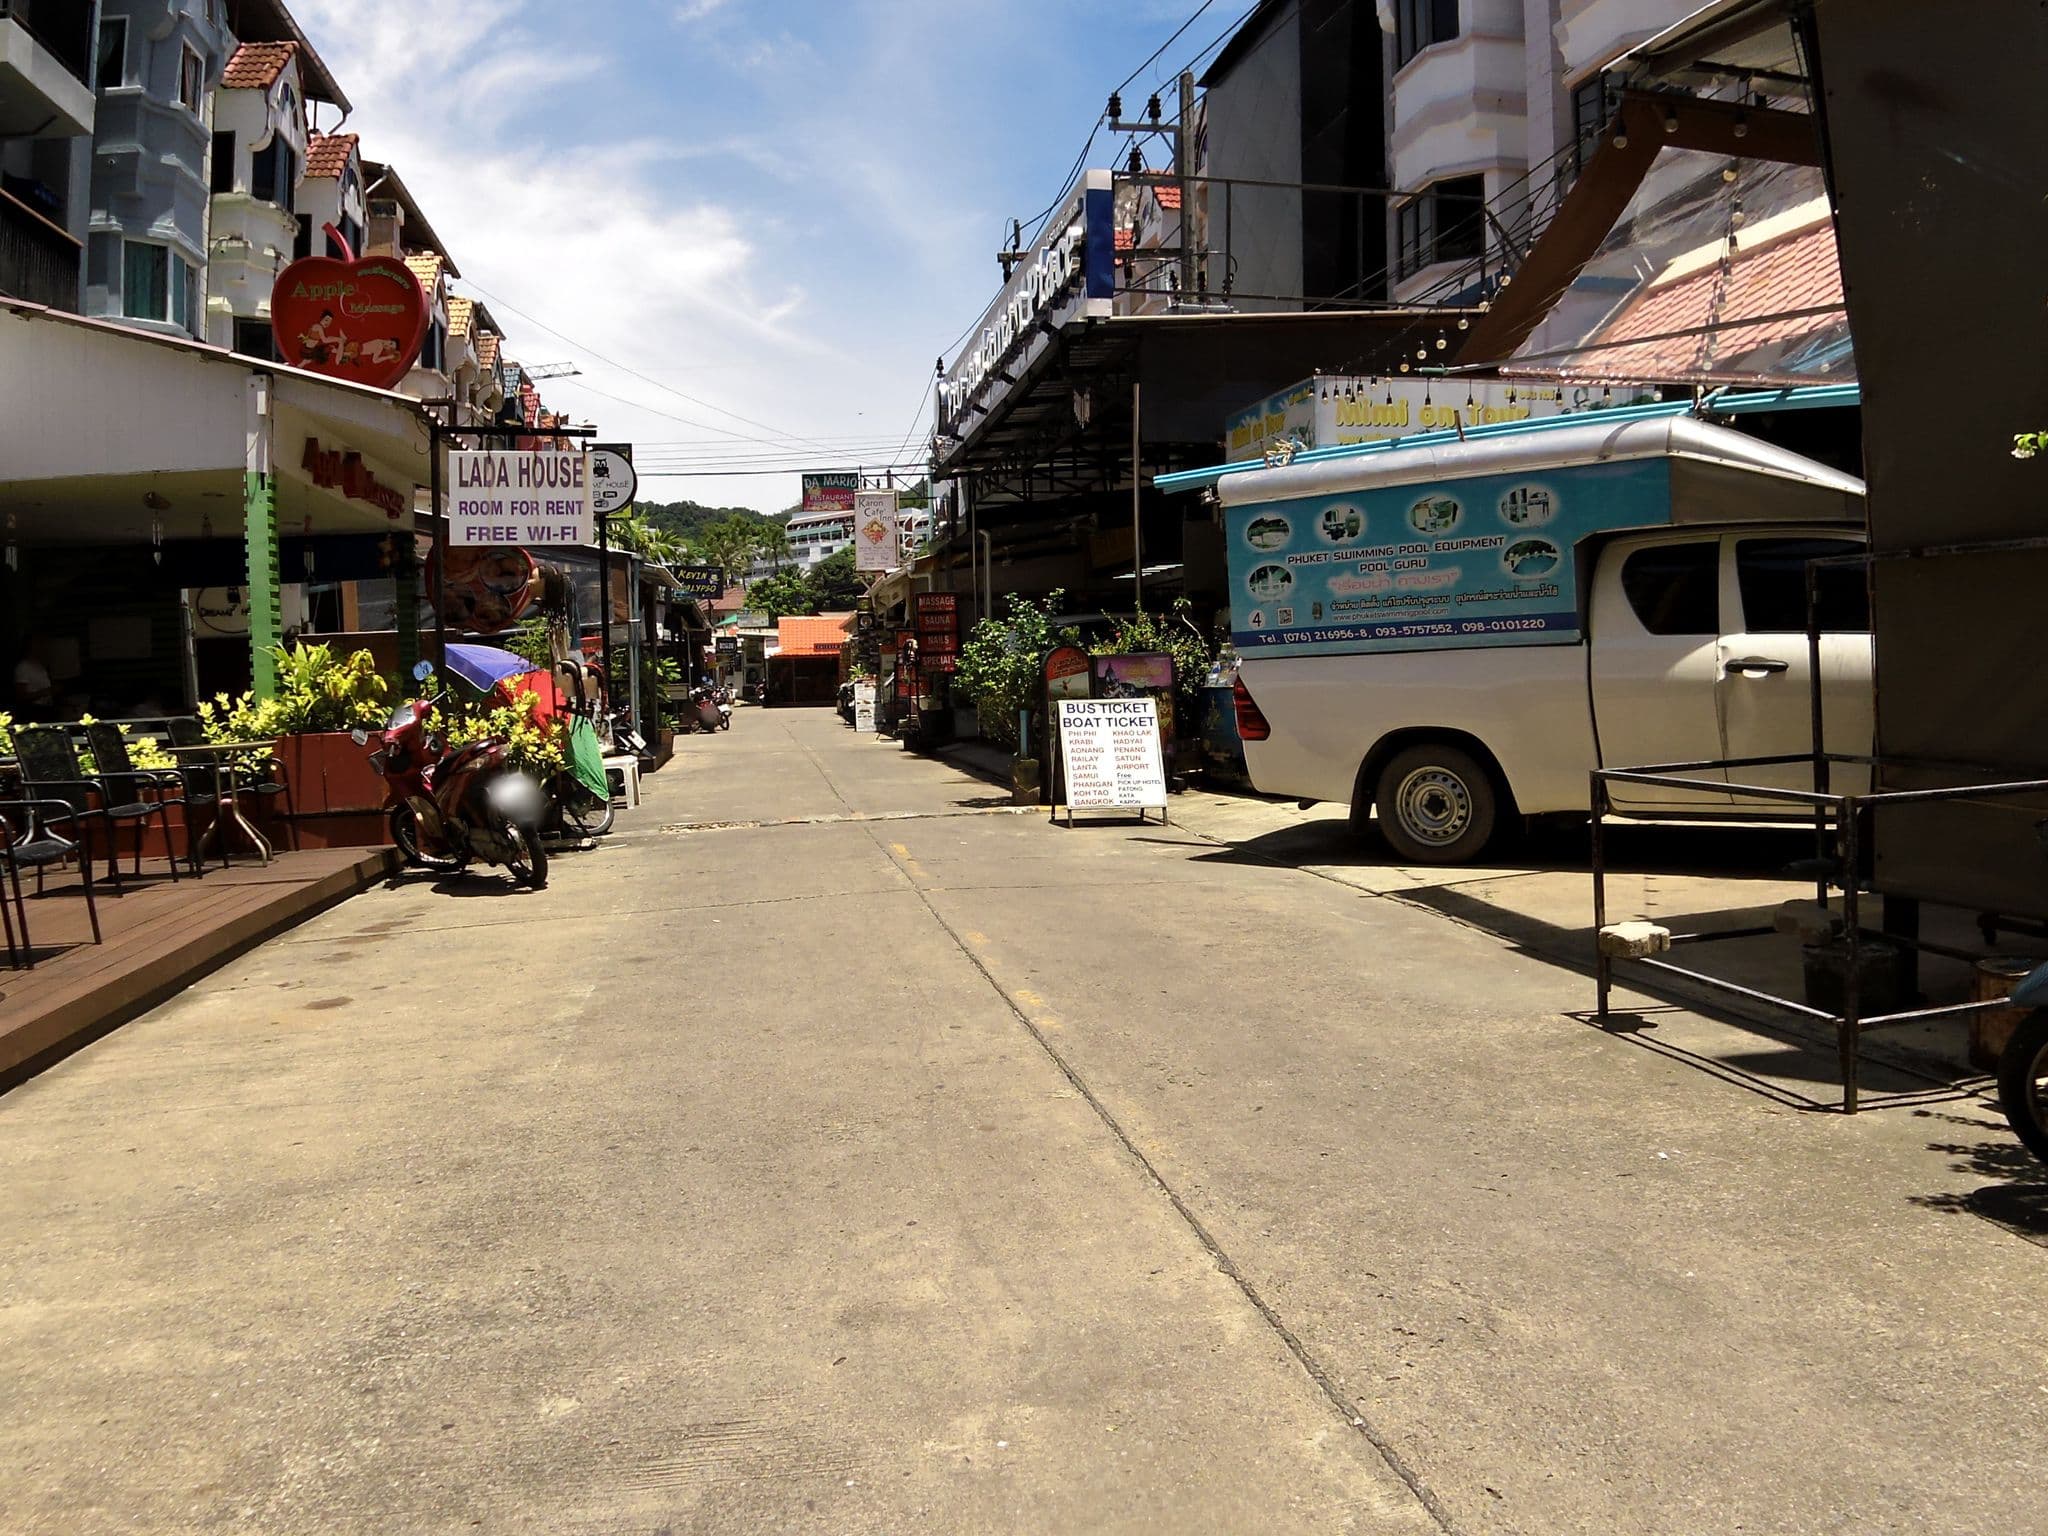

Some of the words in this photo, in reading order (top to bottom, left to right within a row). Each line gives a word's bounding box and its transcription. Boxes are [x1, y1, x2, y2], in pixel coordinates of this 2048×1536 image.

[291, 280, 355, 301] Apple
[458, 456, 509, 488] LADA
[518, 456, 584, 488] HOUSE
[804, 477, 820, 489] DA
[823, 475, 858, 488] MARIO
[458, 500, 503, 515] ROOM
[511, 500, 540, 515] FOR
[546, 500, 584, 515] RENT
[858, 498, 884, 508] Karon
[466, 526, 518, 541] FREE
[527, 526, 578, 541] WI-FI
[1288, 553, 1328, 564] PHUKET
[1333, 547, 1394, 561] SWIMMING
[1399, 543, 1429, 554] POOL
[1435, 537, 1505, 551] EQUIPMENT
[1360, 562, 1389, 572] POOL
[1394, 559, 1427, 570] GURU
[918, 596, 955, 606] MASSAGE
[925, 615, 950, 625] SAUNA
[1252, 611, 1262, 627] 4
[1259, 634, 1280, 644] Tel.
[1283, 631, 1312, 644] [076]
[1315, 628, 1372, 641] 216956-8,
[1375, 623, 1458, 637] 093-5757552,
[1461, 618, 1546, 632] 098-0101220
[927, 635, 950, 645] NAILS
[1066, 703, 1096, 714] BUS
[1099, 702, 1149, 714] TICKET
[1063, 717, 1102, 728] BOAT
[1105, 716, 1155, 728] TICKET
